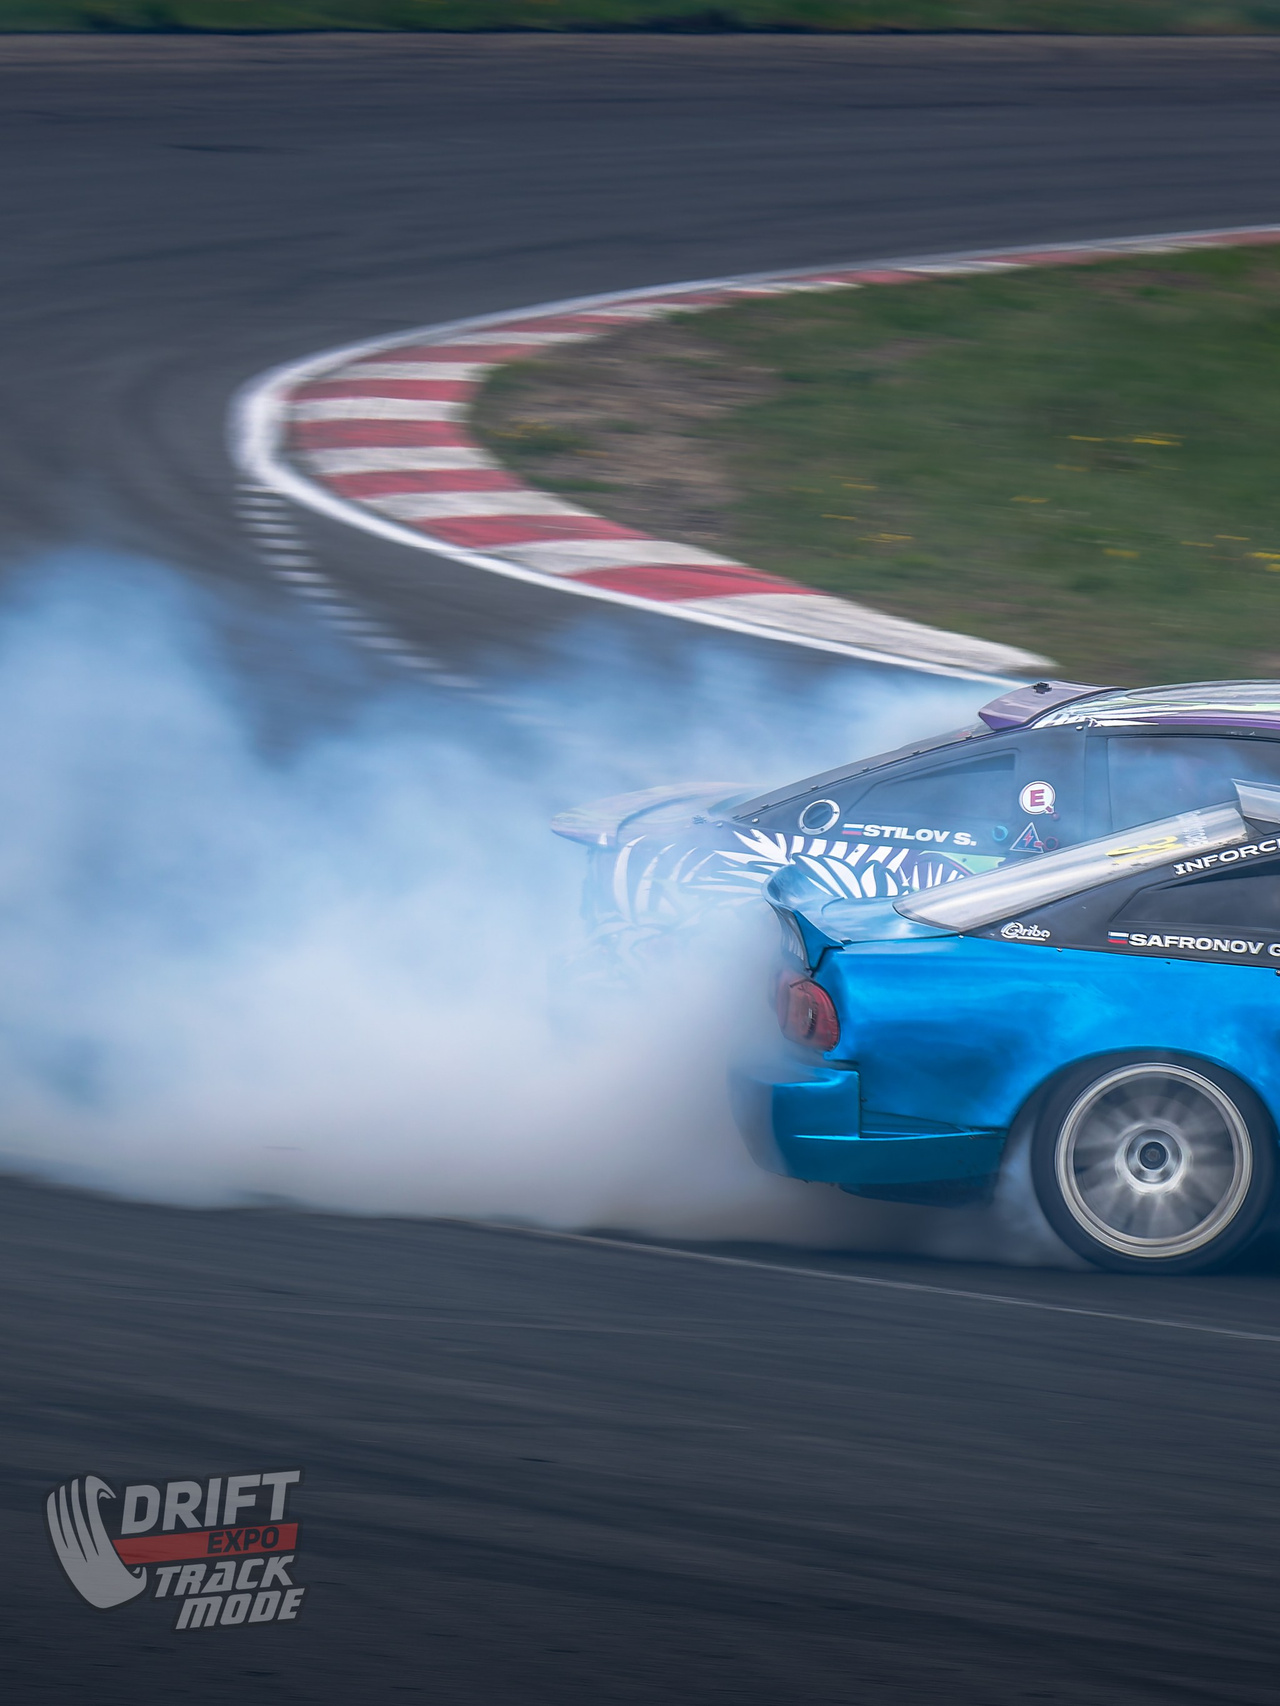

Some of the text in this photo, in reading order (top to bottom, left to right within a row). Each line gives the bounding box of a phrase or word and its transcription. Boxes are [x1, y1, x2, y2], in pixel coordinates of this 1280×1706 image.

[1030, 788, 1045, 807] E
[863, 824, 977, 846] STILOV S.
[1128, 933, 1264, 956] SAFRONOV
